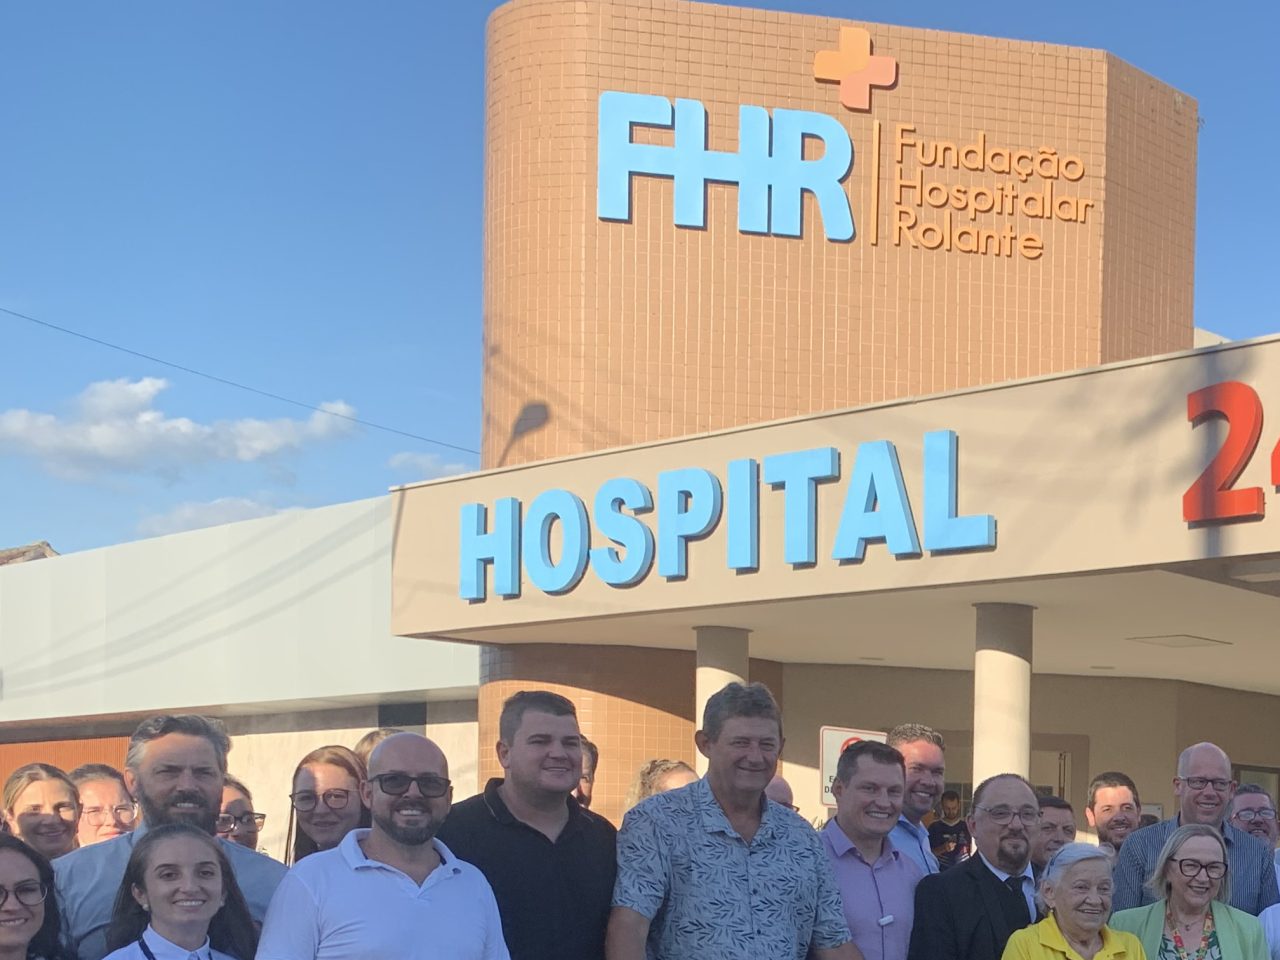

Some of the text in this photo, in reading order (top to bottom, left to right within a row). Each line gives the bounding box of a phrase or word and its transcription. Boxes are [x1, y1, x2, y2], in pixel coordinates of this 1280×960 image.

[598, 90, 857, 243] FHR
[895, 123, 1085, 182] Fundação
[894, 166, 1095, 223] Hospitalar
[894, 206, 1044, 260] Rolante
[459, 429, 997, 603] HOSPITAL
